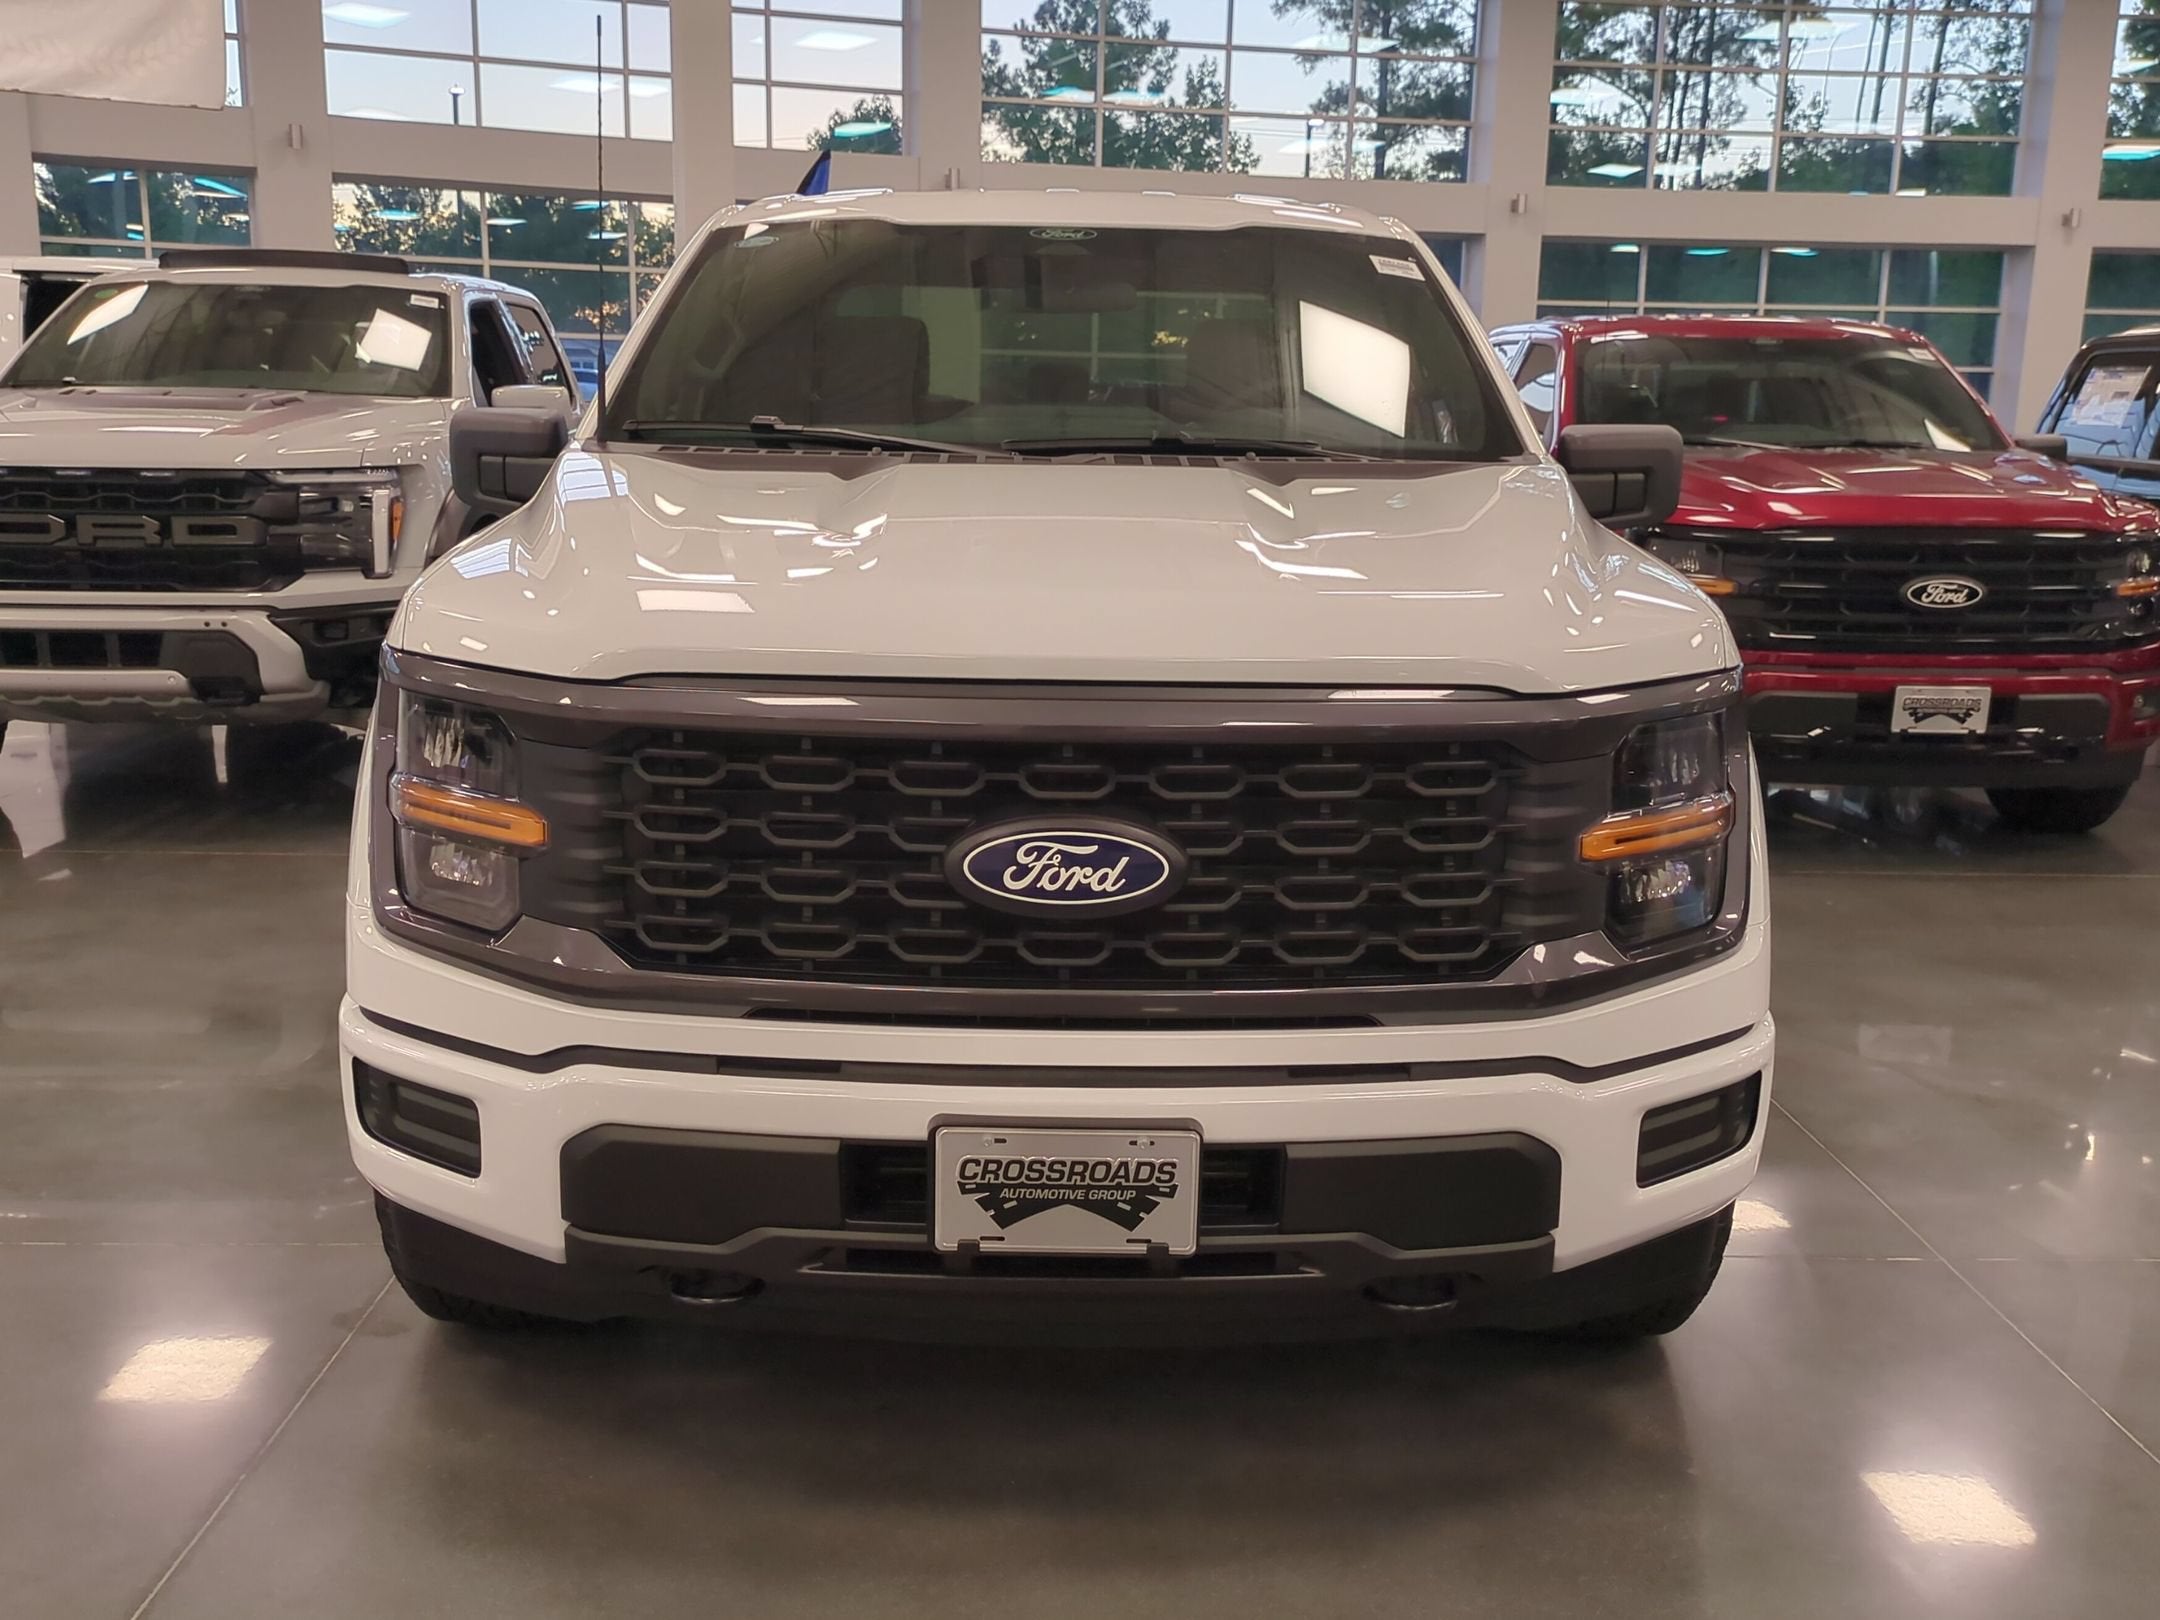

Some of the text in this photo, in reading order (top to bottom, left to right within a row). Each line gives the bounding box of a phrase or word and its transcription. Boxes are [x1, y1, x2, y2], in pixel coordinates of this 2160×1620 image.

[1921, 583, 1969, 603] Ford
[1903, 697, 1982, 708] CROSSROADS
[1003, 841, 1130, 892] Ford
[958, 1157, 1178, 1185] CROSSROADS
[1000, 1187, 1136, 1201] AUTOMOTIVE GROUP
